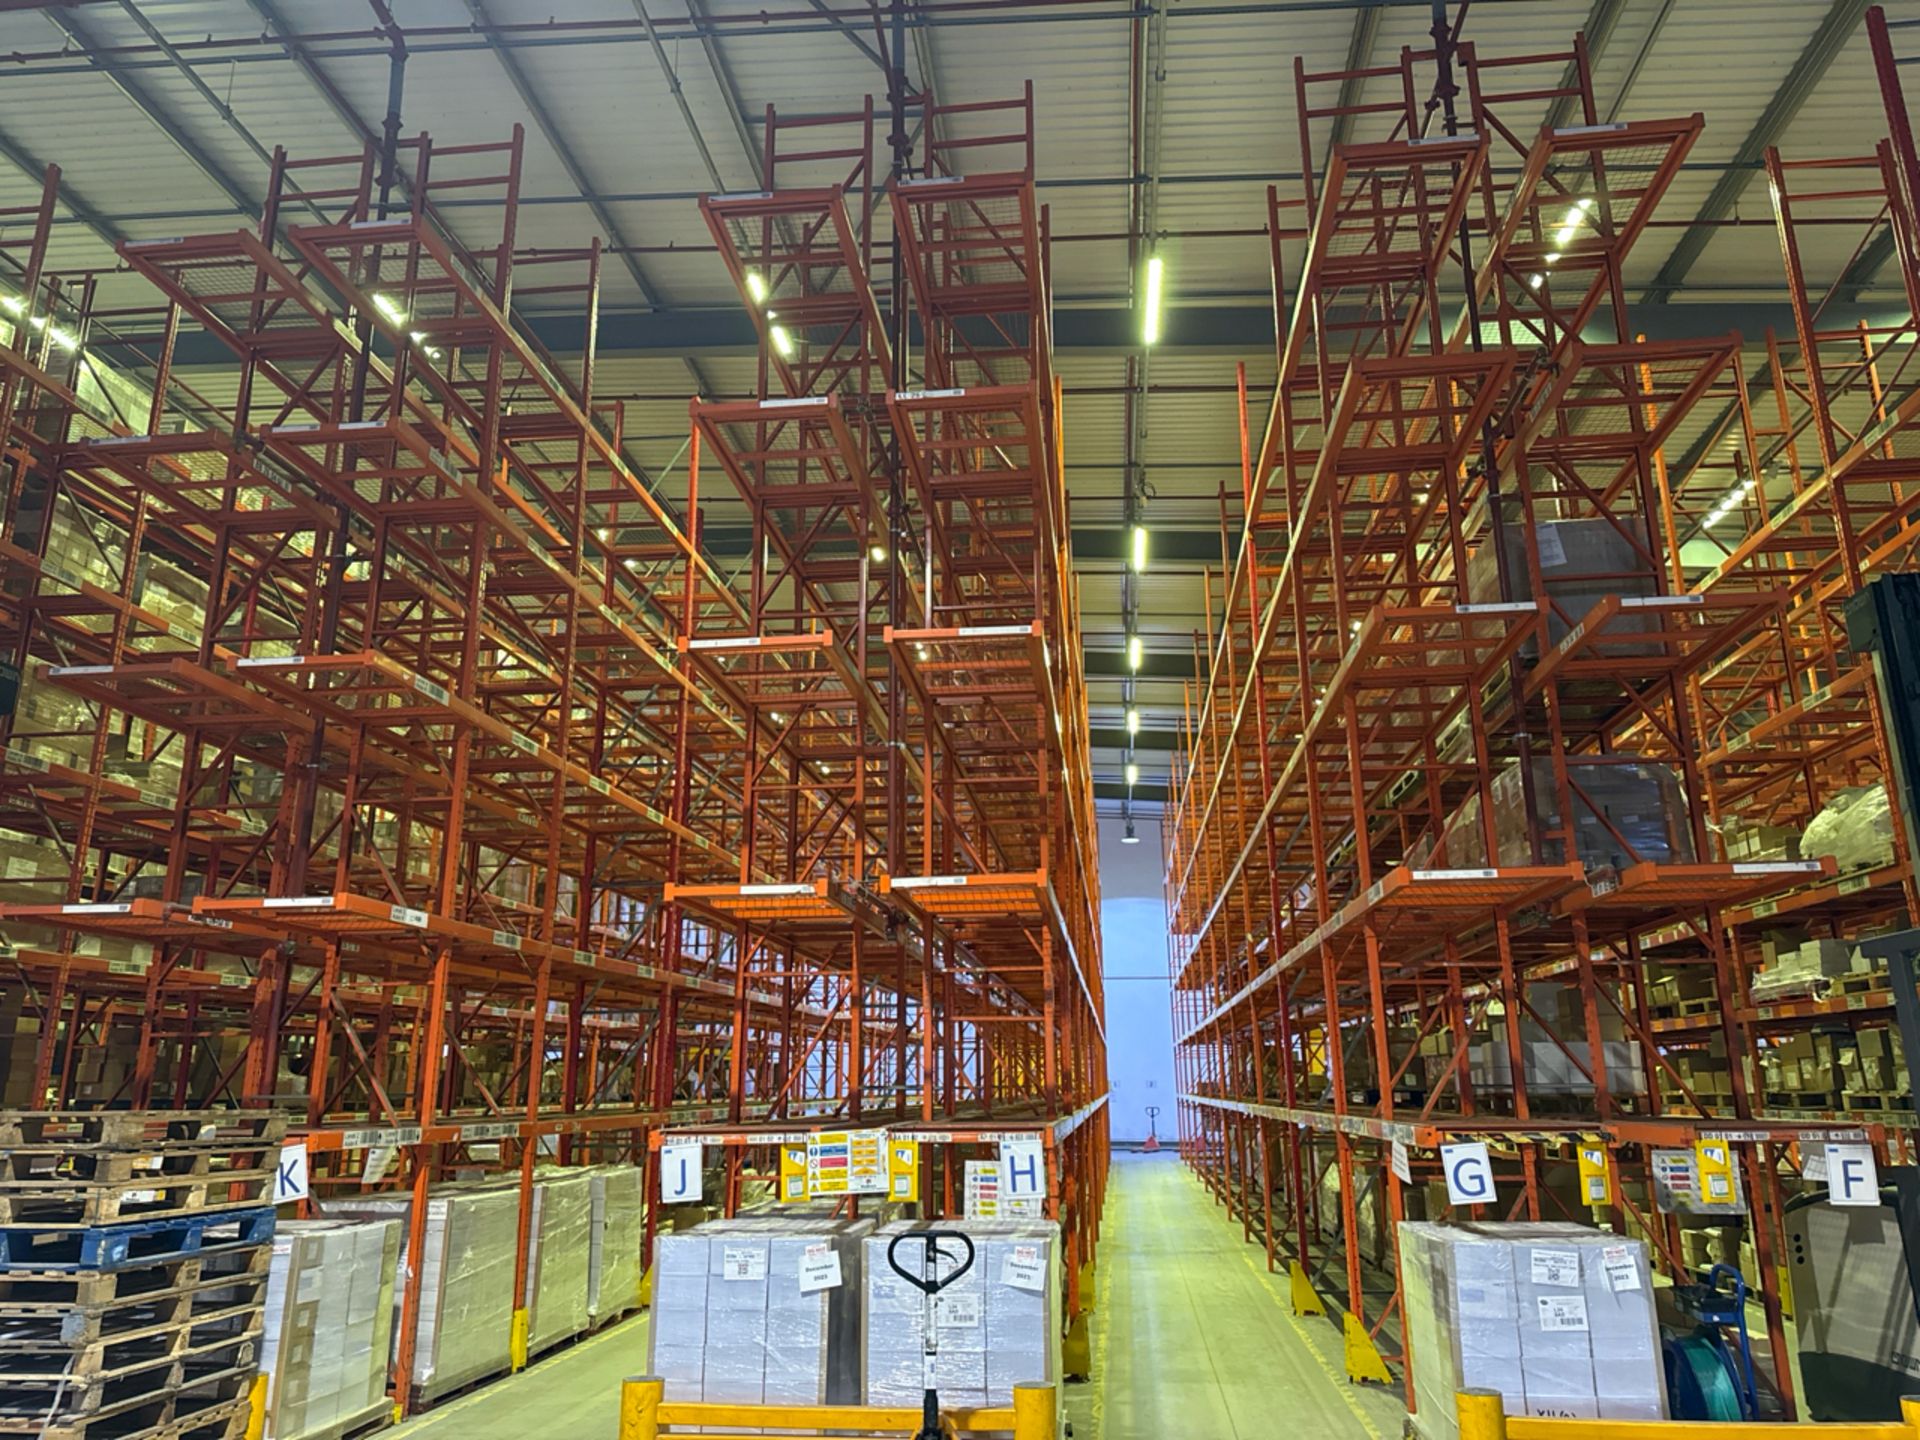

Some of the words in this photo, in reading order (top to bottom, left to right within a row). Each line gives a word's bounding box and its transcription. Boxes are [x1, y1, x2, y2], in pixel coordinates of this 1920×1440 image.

[279, 1159, 300, 1196] K
[674, 1158, 687, 1196] J
[1009, 1154, 1037, 1193] H
[1452, 1157, 1487, 1197] G
[1842, 1159, 1864, 1198] F
[805, 1263, 834, 1273] December
[1010, 1261, 1039, 1272] December
